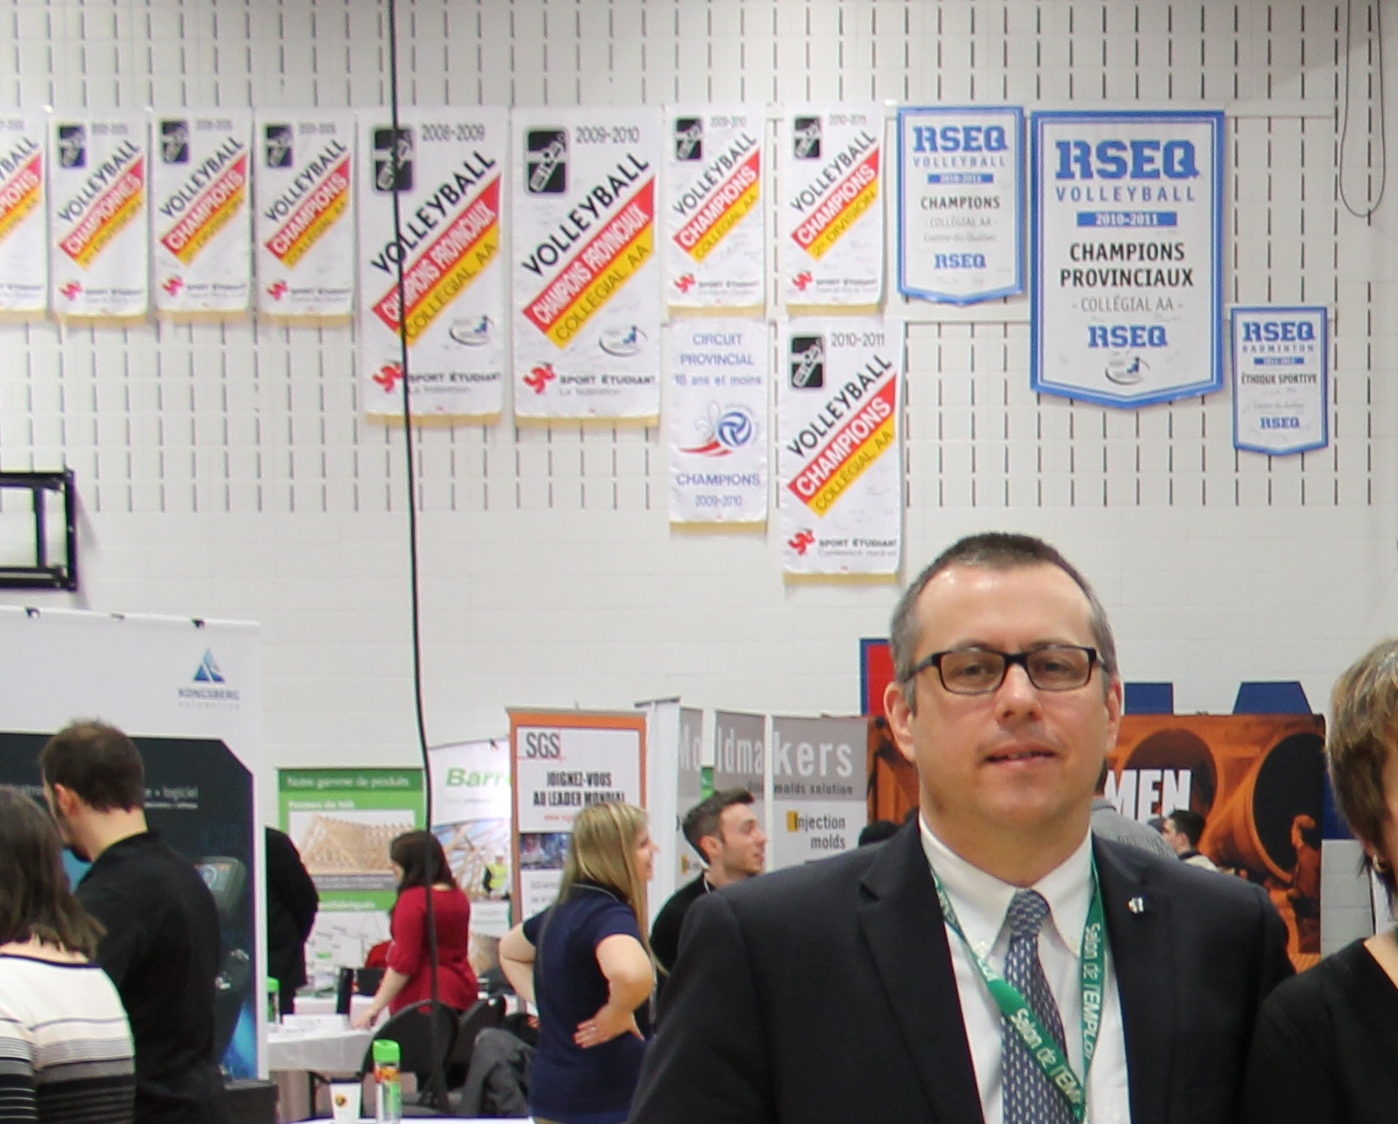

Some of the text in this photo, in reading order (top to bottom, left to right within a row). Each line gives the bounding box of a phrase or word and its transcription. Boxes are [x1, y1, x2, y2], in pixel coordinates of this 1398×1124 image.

[576, 125, 640, 144] 2009-2010
[913, 125, 1008, 152] RSEQ
[913, 156, 1005, 167] VOLLEYBALL
[1055, 139, 1200, 180] RSEQ
[57, 139, 140, 222] VOLLEYBALL
[160, 136, 243, 219] VOLLEYBALL
[264, 139, 347, 224] VOLLEYBALL
[672, 133, 757, 217] VOLLEYBALL
[790, 131, 877, 213] VOLLEYBALL
[797, 163, 876, 245] CHAMPIONS
[921, 196, 1000, 210] CHAMPIONS
[1055, 186, 1195, 201] VOLLEYBALL
[168, 170, 245, 250] CHAMPIONS
[272, 172, 348, 255] CHAMPIONS
[371, 151, 497, 275] VOLLEYBALL
[522, 153, 650, 278] VOLLEYBALL
[679, 165, 757, 247] CHAMPIONS
[1095, 213, 1159, 226] 2010-2011
[431, 200, 496, 268] PROVINCIAUX
[532, 201, 650, 324] CHAMPIONS PROVINCIAUX
[628, 242, 650, 268] AA
[934, 253, 987, 269] RSEQ
[1069, 242, 1185, 262] CHAMPIONS
[1060, 268, 1194, 288] PROVINCIAUX
[1080, 294, 1174, 312] COLLÉGIAL AA
[692, 333, 742, 346] CIRCUIT
[831, 333, 886, 347] 2010-2011
[1087, 325, 1168, 348] RSEQ
[1242, 321, 1315, 342] RSEQ
[679, 354, 754, 366] PROVINCIAL
[560, 375, 596, 385] SPORT
[1241, 374, 1317, 385] ÉTHIQUE SPORTIVE
[786, 354, 893, 458] VOLLEYBALL
[1260, 417, 1300, 428] RSEQ
[796, 396, 891, 497] CHAMPIONS
[874, 429, 893, 452] AA
[676, 474, 760, 487] CHAMPIONS
[526, 732, 561, 758] SGS
[547, 771, 612, 787] JOIGNEZ-VOUS
[774, 783, 806, 795] molds
[810, 783, 853, 795] solution
[533, 791, 547, 807] AU
[549, 791, 582, 807] LEADER
[810, 834, 846, 849] molds
